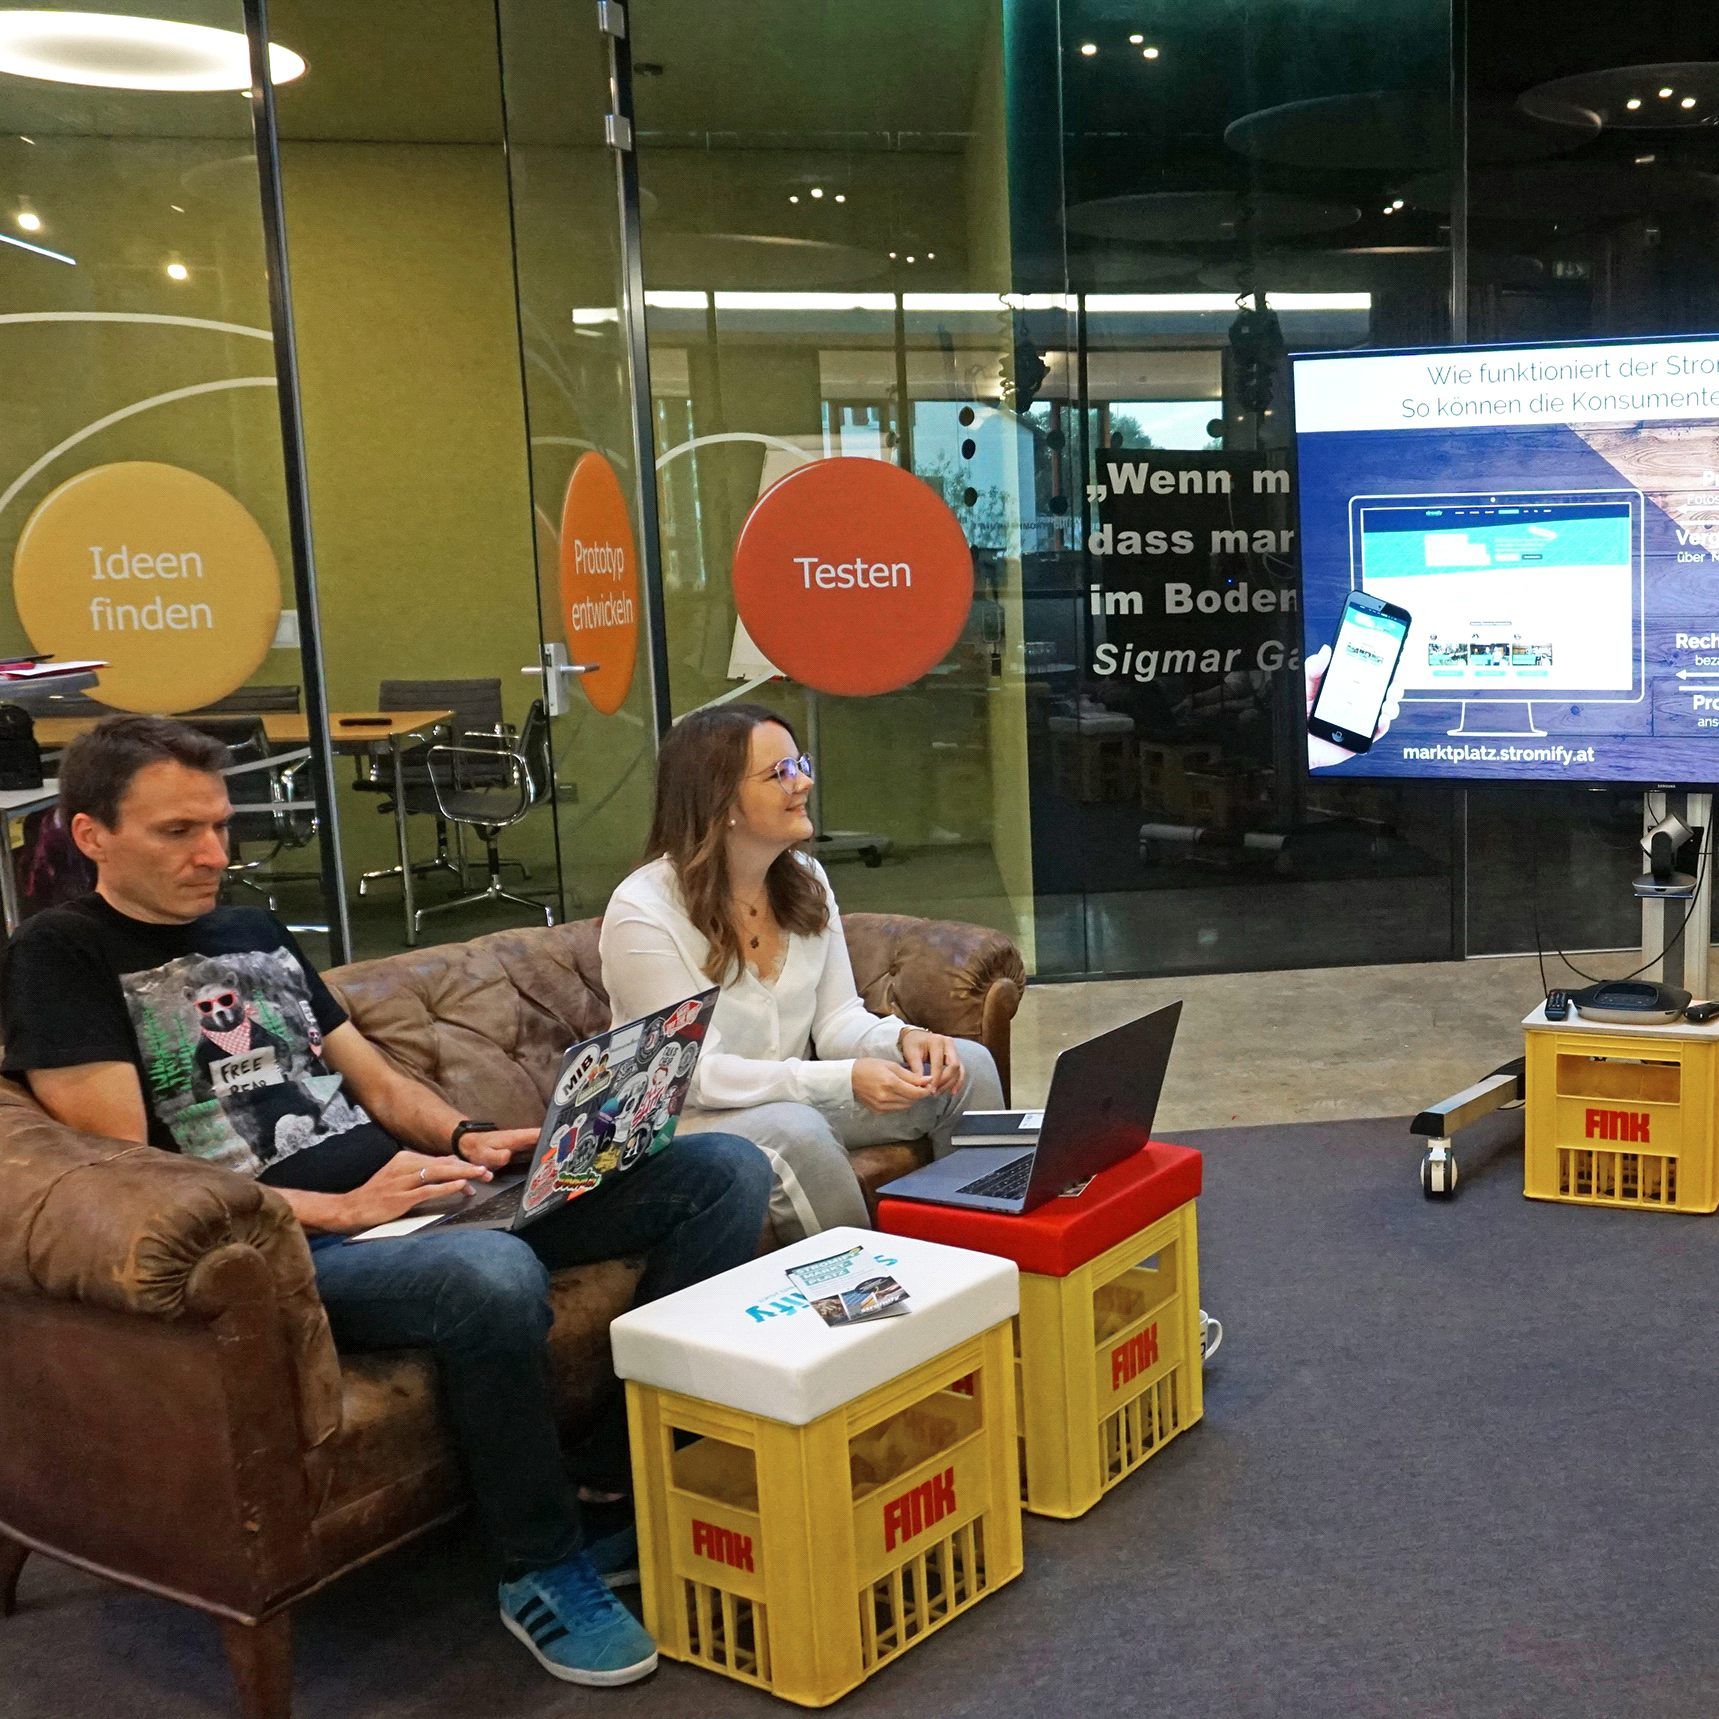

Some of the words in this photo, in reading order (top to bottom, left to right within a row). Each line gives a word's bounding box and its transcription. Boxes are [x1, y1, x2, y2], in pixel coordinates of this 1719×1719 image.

[1427, 364, 1472, 386] Wie
[1479, 358, 1610, 384] funktioniert
[1619, 357, 1658, 377] der
[1666, 354, 1719, 376] Stro
[1401, 398, 1430, 419] So
[1437, 394, 1522, 417] können
[1529, 393, 1564, 414] die
[1572, 387, 1719, 411] Konsumente
[1088, 523, 1195, 556] dass
[1677, 551, 1706, 563] über
[88, 544, 204, 581] Ideen
[574, 538, 625, 582] Prototyp
[792, 557, 912, 590] Testen
[89, 594, 214, 632] finden
[571, 590, 634, 632] entwickeln
[1089, 583, 1144, 616] im
[1164, 581, 1298, 615] Boden
[1092, 642, 1242, 683] Sigmar
[1402, 744, 1596, 767] marktplatz.stromify.at
[220, 1056, 263, 1084] FREE
[561, 1054, 594, 1097] MIB
[1585, 1107, 1650, 1143] FINK
[1110, 1321, 1159, 1392] FINK
[883, 1465, 957, 1553] FINK
[691, 1518, 755, 1573] FINK
